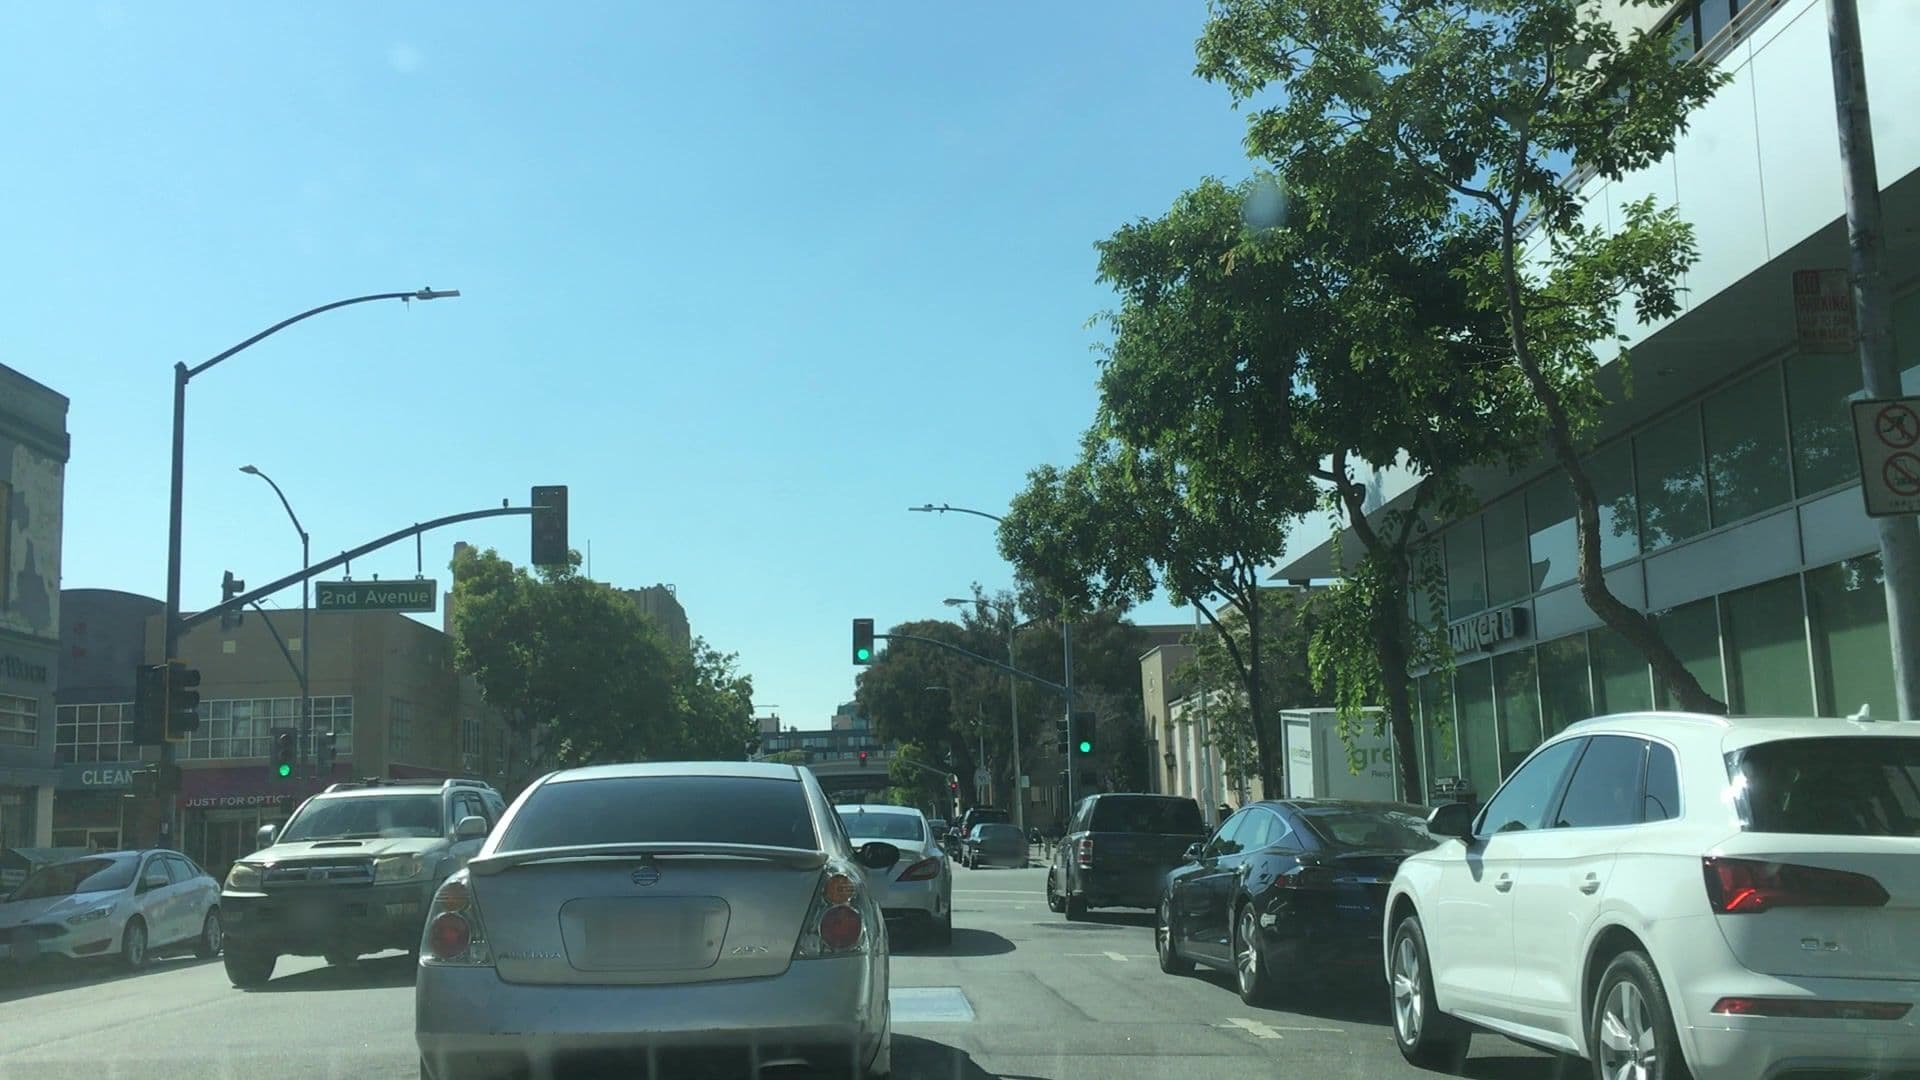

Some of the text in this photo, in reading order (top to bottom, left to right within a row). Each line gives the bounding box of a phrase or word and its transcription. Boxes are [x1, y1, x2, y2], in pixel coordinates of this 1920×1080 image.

[321, 590, 429, 605] 2nd Avenue
[185, 797, 218, 807] JUST
[219, 796, 244, 806] FOR
